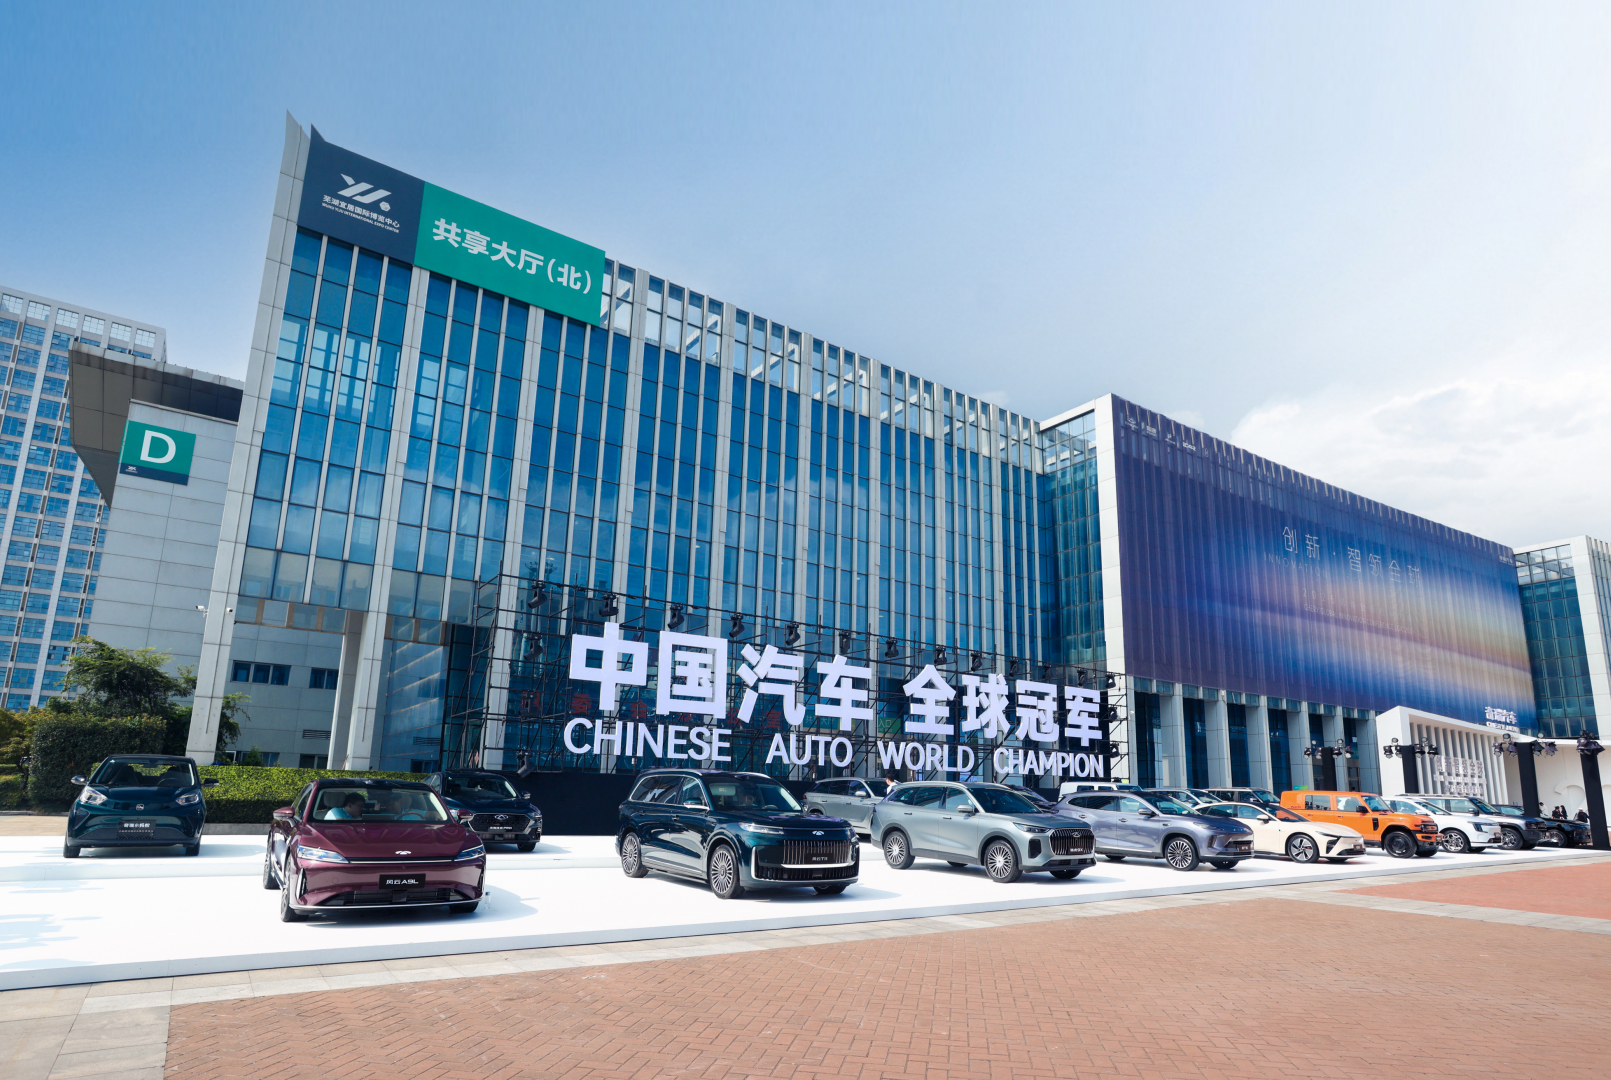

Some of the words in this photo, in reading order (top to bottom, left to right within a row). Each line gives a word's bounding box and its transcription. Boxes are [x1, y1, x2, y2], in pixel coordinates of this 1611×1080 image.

[323, 195, 400, 228] 芜湖宜居国际博览中心
[140, 430, 176, 464] D
[569, 621, 873, 731] 中国汽车
[903, 664, 1102, 746] 全球冠军
[564, 717, 732, 762] CHINESE
[766, 733, 853, 767] AUTO
[877, 741, 974, 773] WORLD
[993, 747, 1104, 778] CHAMPION
